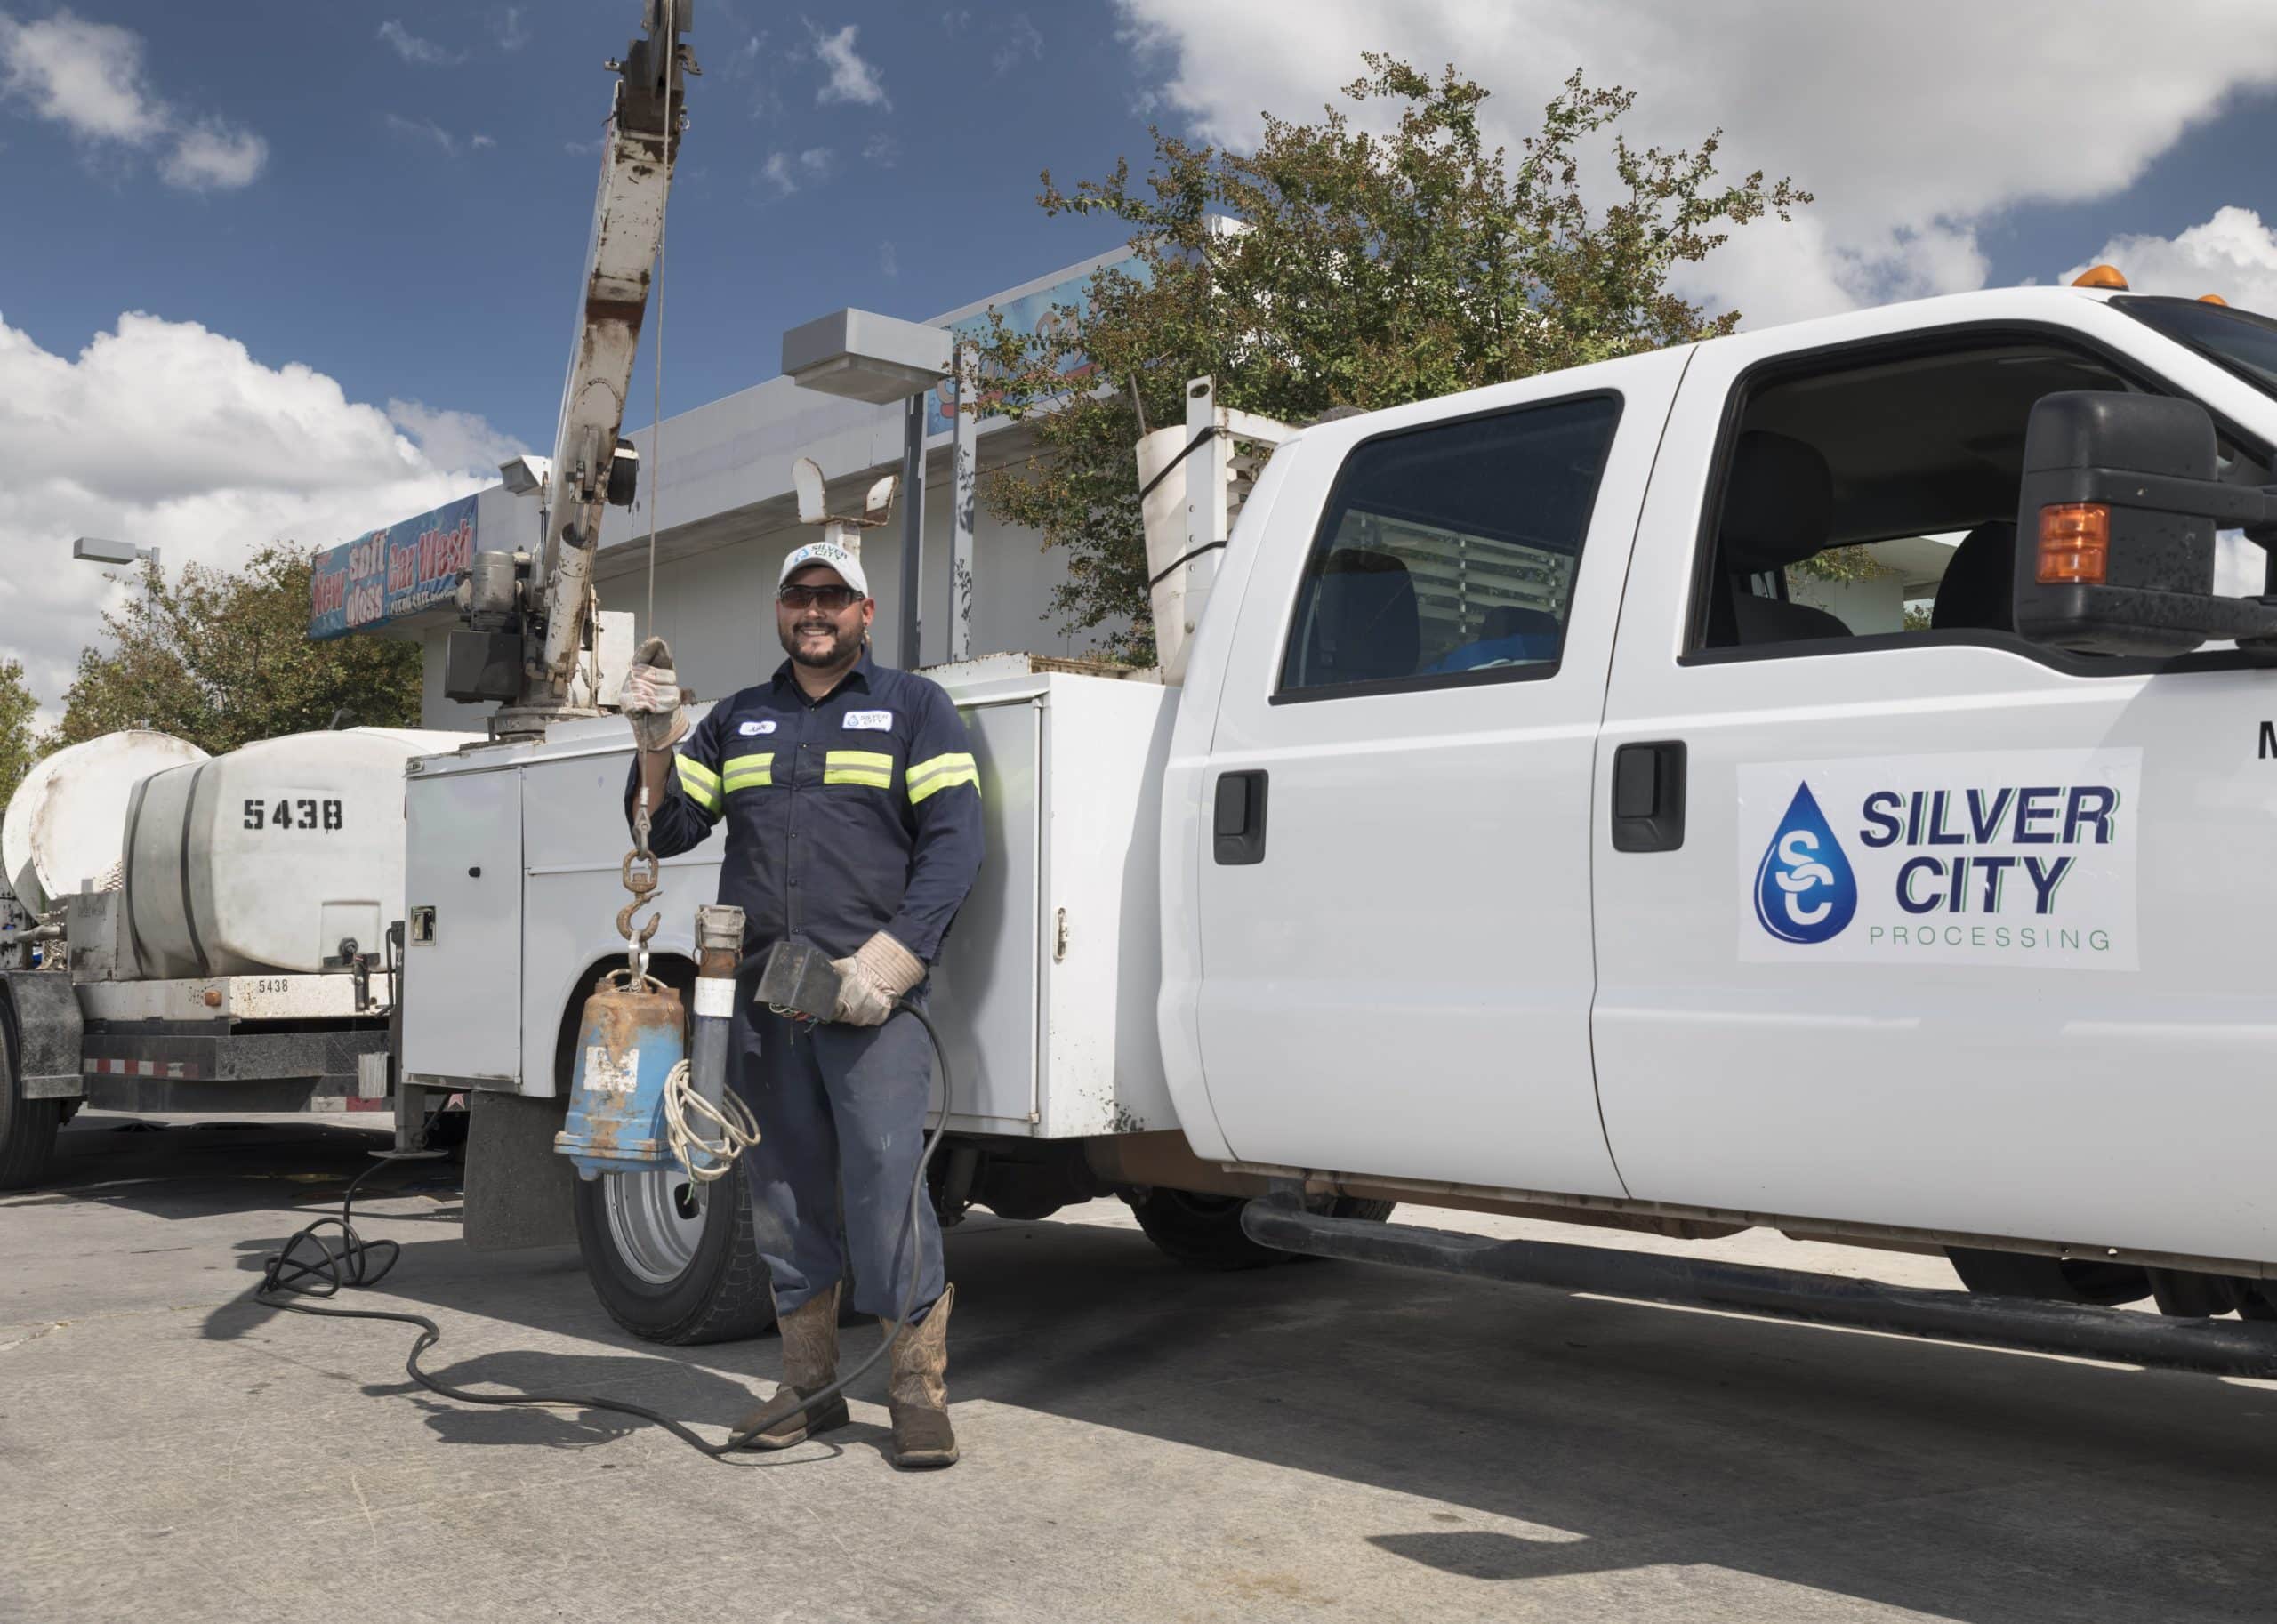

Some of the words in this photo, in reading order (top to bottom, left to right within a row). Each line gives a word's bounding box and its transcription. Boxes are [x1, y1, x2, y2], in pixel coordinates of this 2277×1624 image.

[387, 543, 417, 595] Car
[418, 519, 473, 584] Wash
[811, 543, 848, 559] SILVER
[815, 550, 841, 560] CITY
[244, 799, 342, 831] 5438
[1859, 784, 2121, 848] SILVER
[1895, 856, 2077, 916] CITY
[1869, 925, 2111, 952] PROCESSING
[259, 979, 288, 993] 5438
